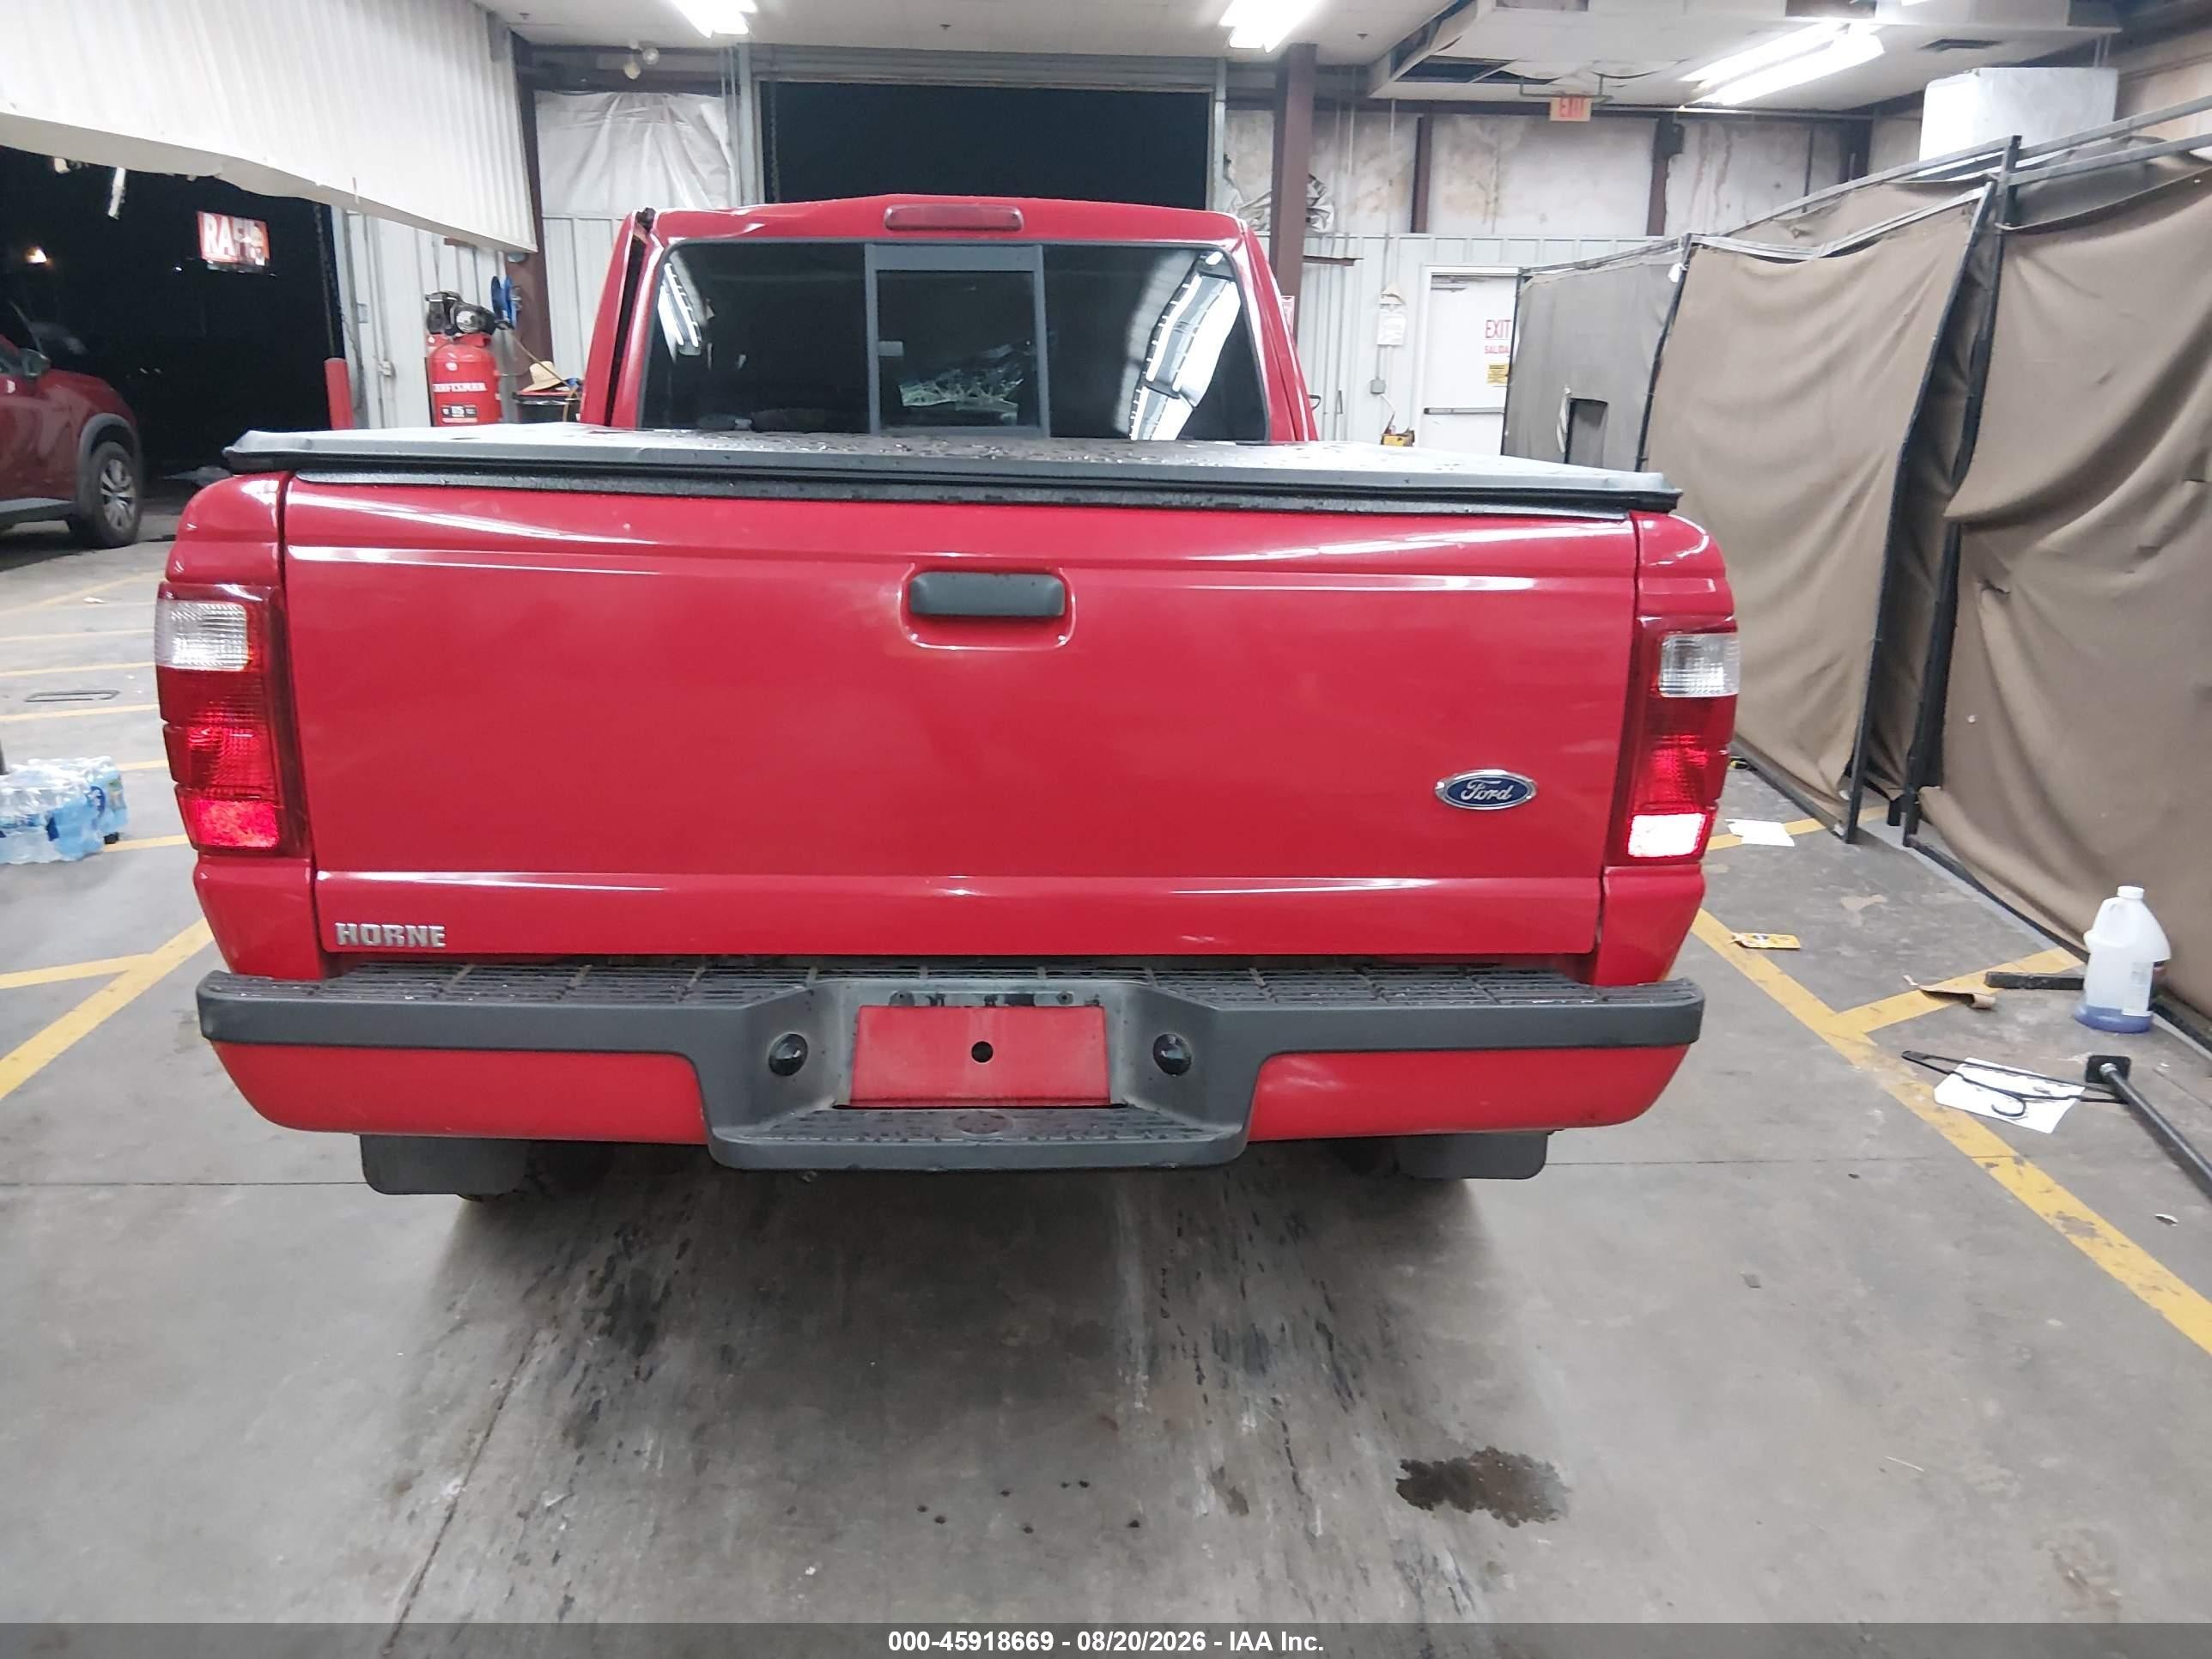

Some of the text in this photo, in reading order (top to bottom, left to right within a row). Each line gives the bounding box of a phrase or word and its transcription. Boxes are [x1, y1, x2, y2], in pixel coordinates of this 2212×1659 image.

[1559, 97, 1584, 118] EXIT
[1485, 319, 1511, 338] EXIT
[1460, 779, 1514, 800] Ford
[335, 922, 447, 948] HORNE
